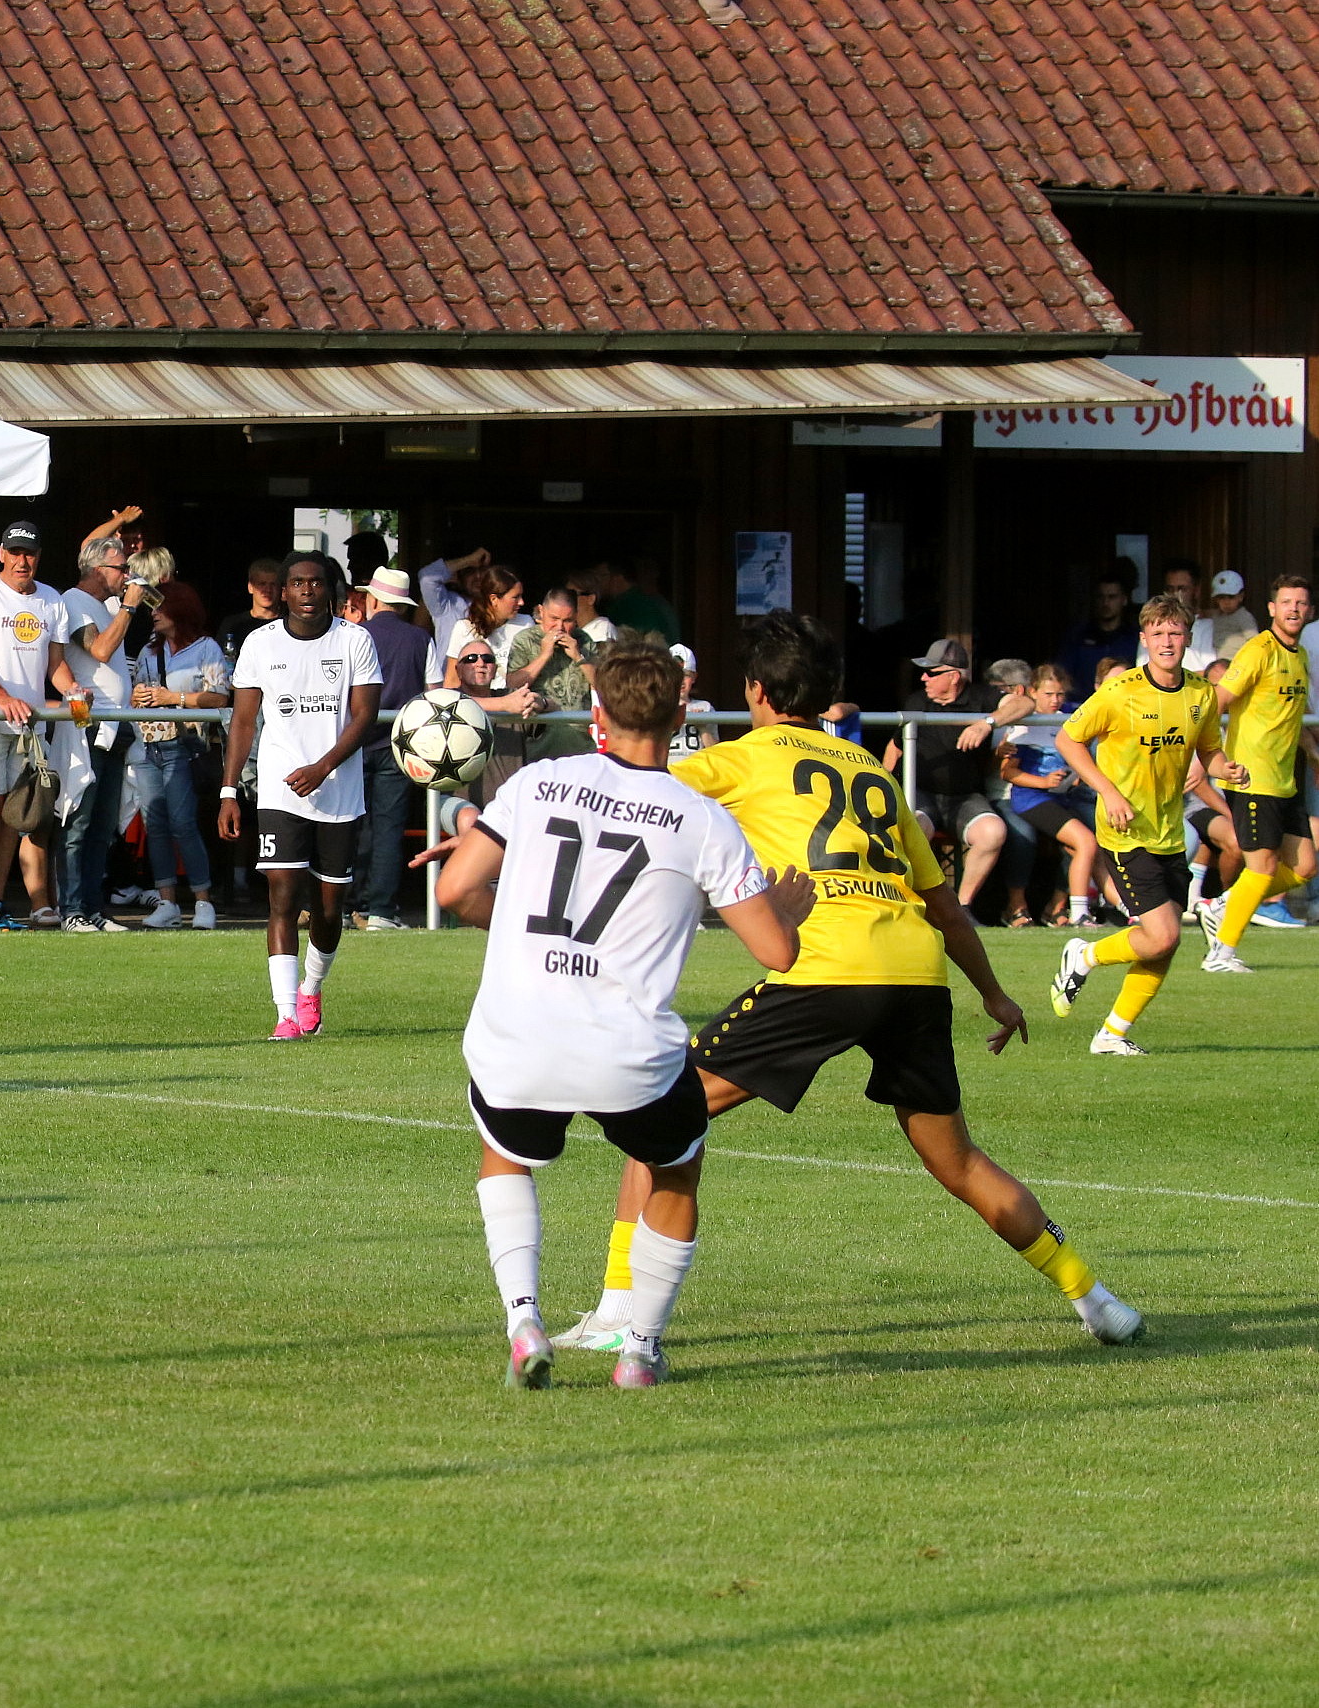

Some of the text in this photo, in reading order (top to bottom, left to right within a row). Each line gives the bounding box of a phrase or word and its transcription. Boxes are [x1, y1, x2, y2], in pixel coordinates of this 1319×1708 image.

[2, 616, 49, 632] Hard Rock
[299, 693, 341, 704] hagebau
[300, 703, 340, 714] bolay
[772, 736, 788, 746] SV
[789, 737, 845, 761] LEONBERG
[1140, 735, 1185, 747] LEWA
[535, 781, 684, 834] SKV RUTESHEIM
[792, 758, 908, 876] 28
[526, 816, 651, 946] 17
[544, 949, 599, 978] GRAU
